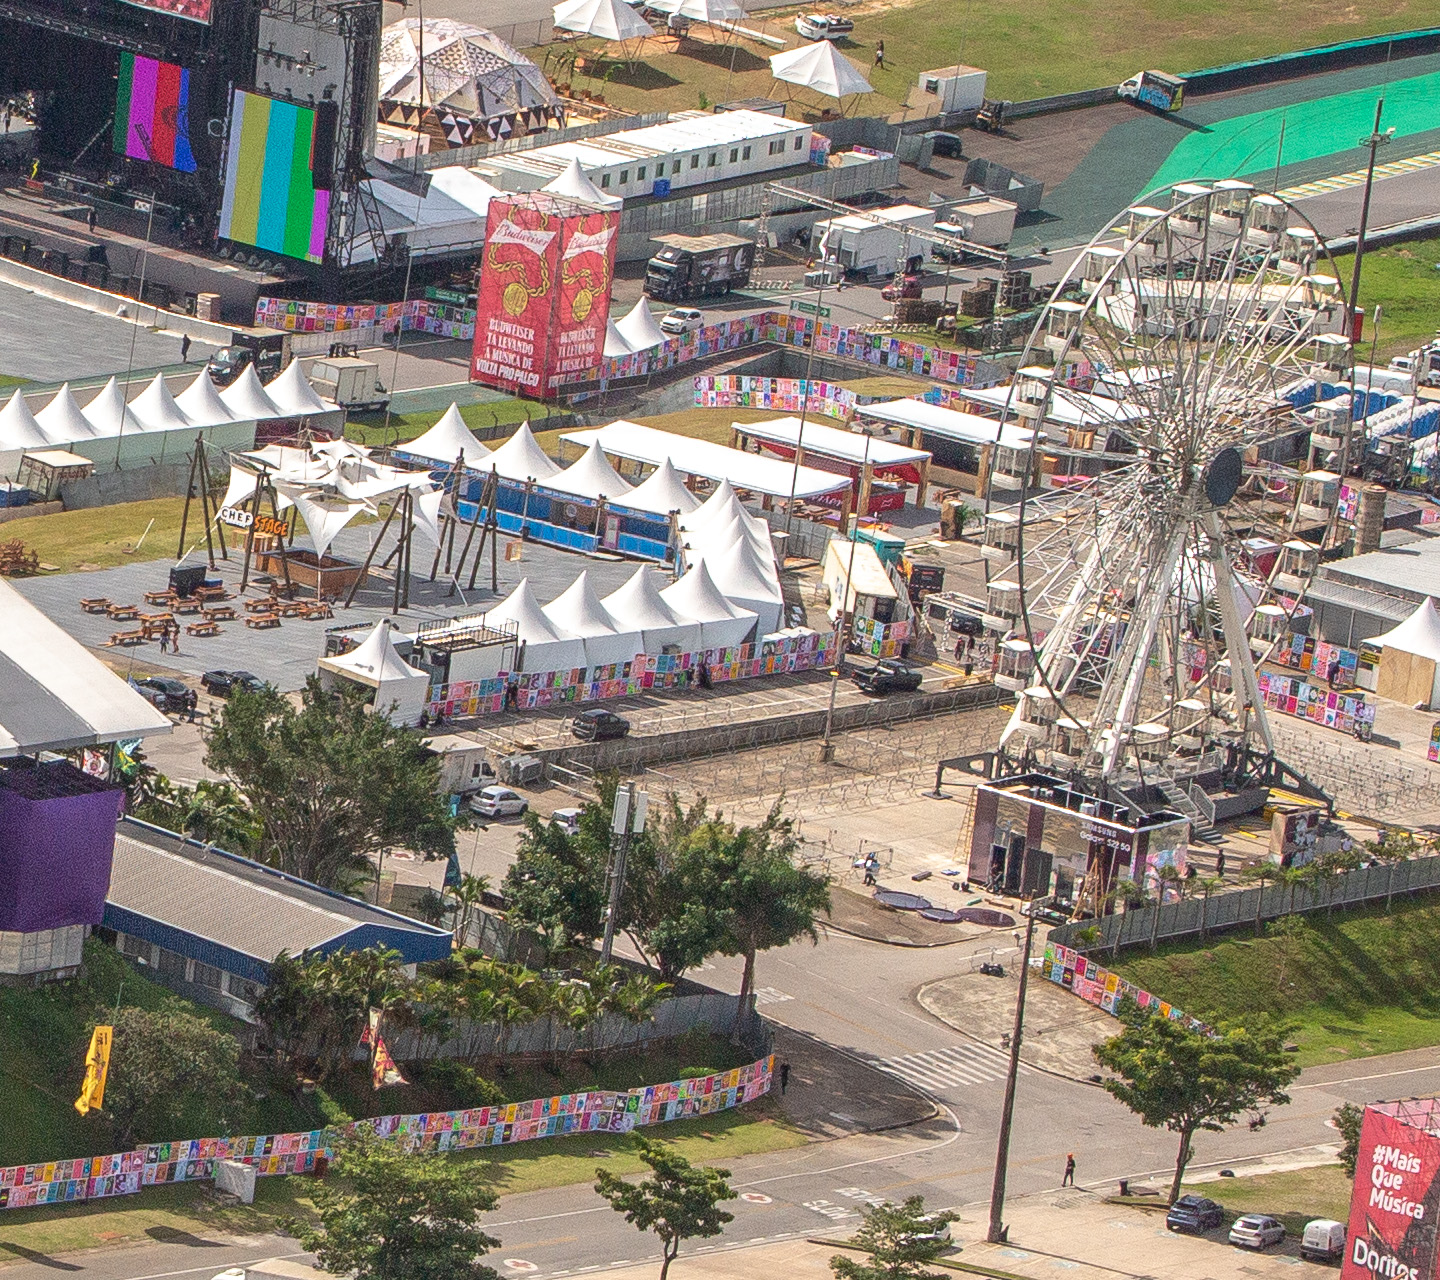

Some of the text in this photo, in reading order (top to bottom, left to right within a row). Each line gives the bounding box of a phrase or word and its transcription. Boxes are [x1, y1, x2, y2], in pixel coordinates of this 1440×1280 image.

[497, 222, 548, 247] Budweiser
[489, 318, 534, 340] BUDWEISER
[498, 335, 533, 355] LEVANDO
[485, 346, 490, 358] A
[522, 357, 533, 370] DE
[476, 358, 539, 387] VOLTA PRO PALCO
[221, 509, 288, 535] CHEF STAGE
[1082, 822, 1117, 837] SAMSUNG
[1373, 1144, 1421, 1174] #Mais
[1372, 1165, 1403, 1190] Que
[1370, 1187, 1424, 1220] Música
